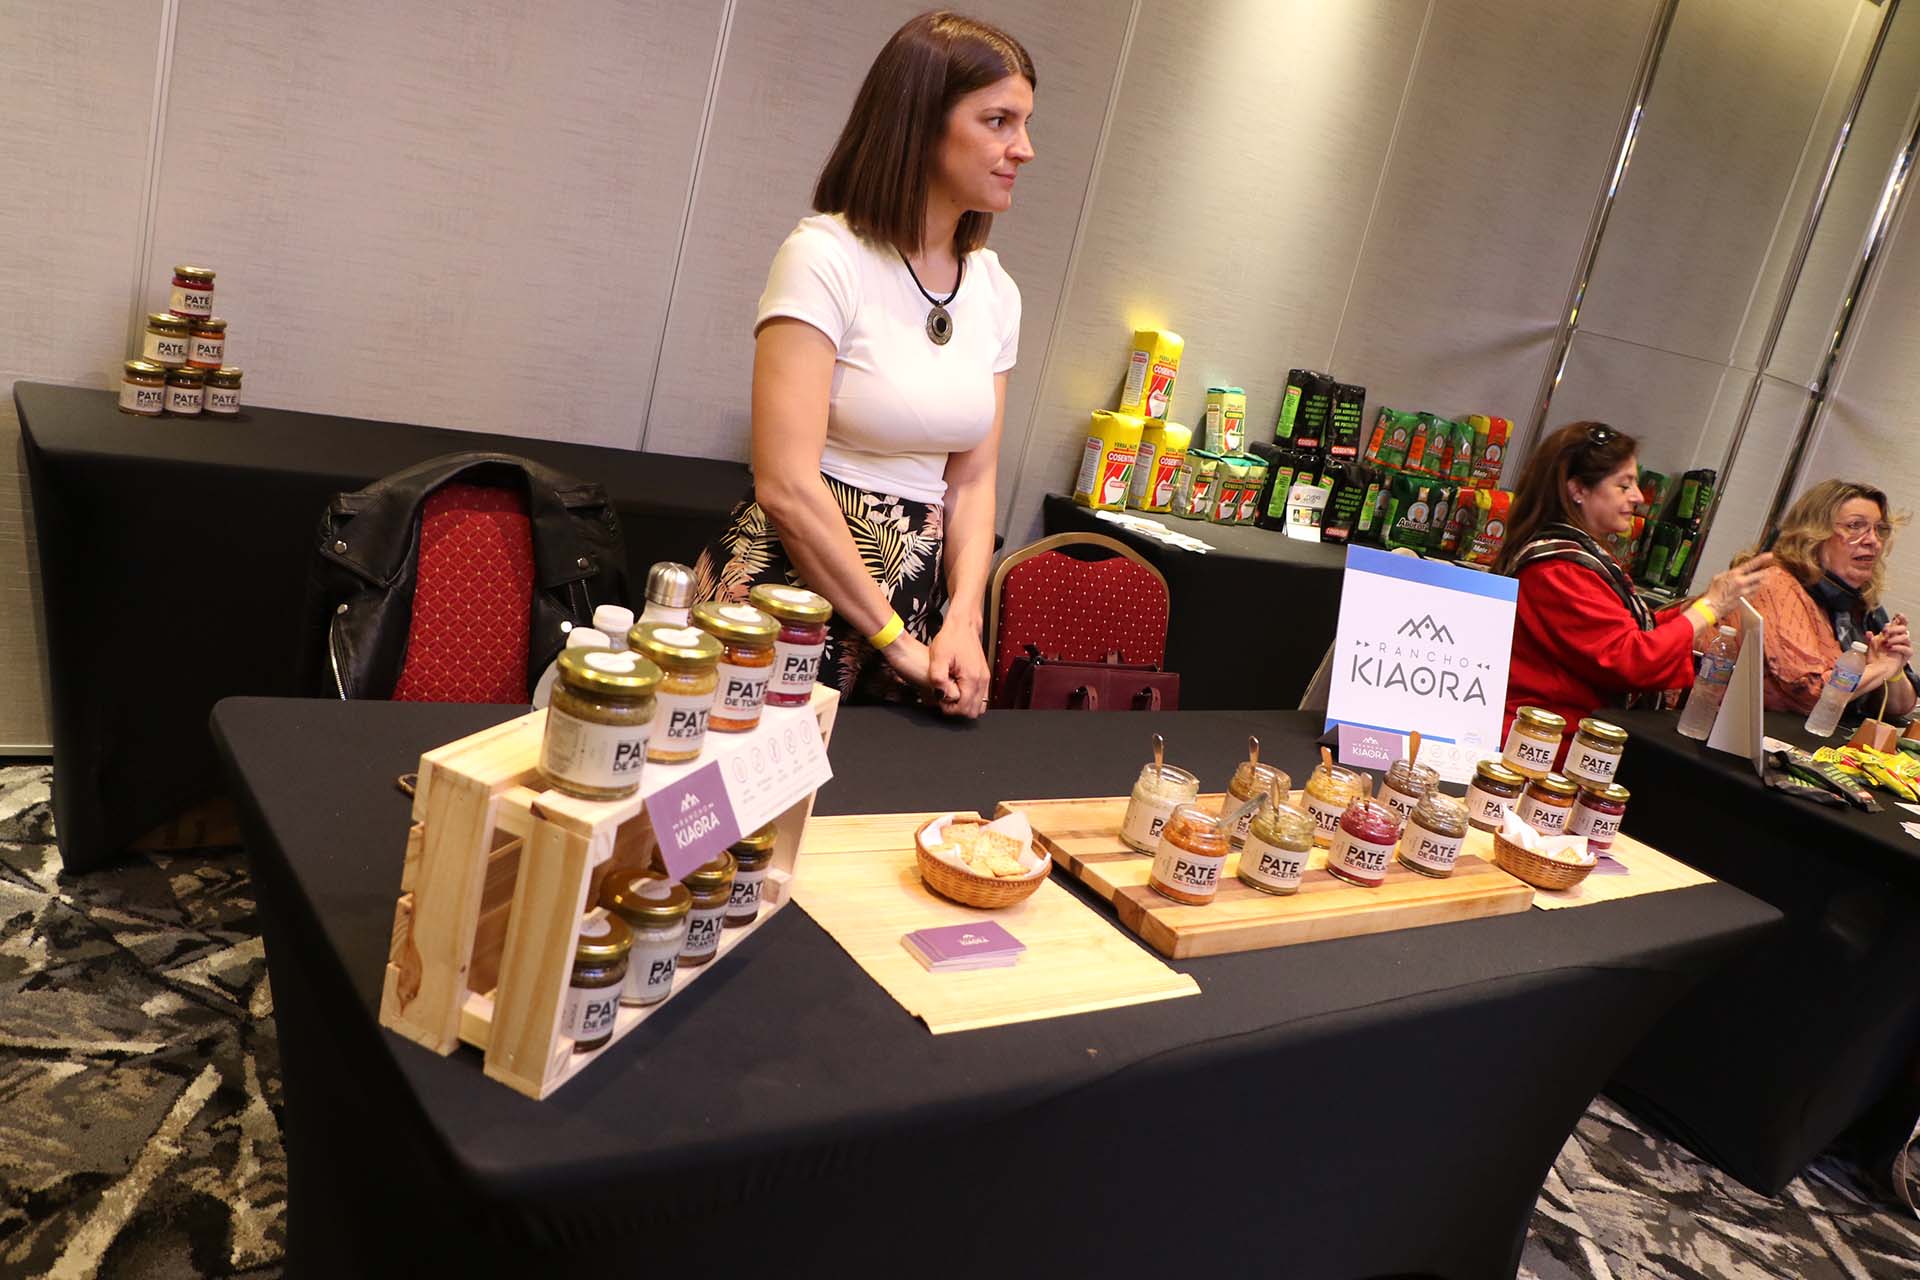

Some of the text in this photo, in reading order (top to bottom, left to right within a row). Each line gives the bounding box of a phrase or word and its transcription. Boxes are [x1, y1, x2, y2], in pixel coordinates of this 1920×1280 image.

[1379, 642, 1470, 673] RANCHO
[782, 672, 796, 683] DE
[1351, 653, 1487, 706] KIAORA
[724, 696, 739, 706] DE
[668, 726, 683, 737] DE
[1352, 746, 1390, 761] KIAORA
[675, 811, 721, 849] KIAORA
[1149, 829, 1160, 838] DE
[1347, 845, 1386, 865] PATÉ
[1417, 849, 1428, 858] DE
[1344, 856, 1355, 866] DE
[1175, 860, 1218, 880] PATÉ
[1258, 864, 1269, 874] DE
[1172, 872, 1184, 881] DE
[728, 894, 743, 904] DE
[687, 932, 700, 941] DE
[648, 974, 661, 985] DE
[582, 1018, 597, 1031] DE
